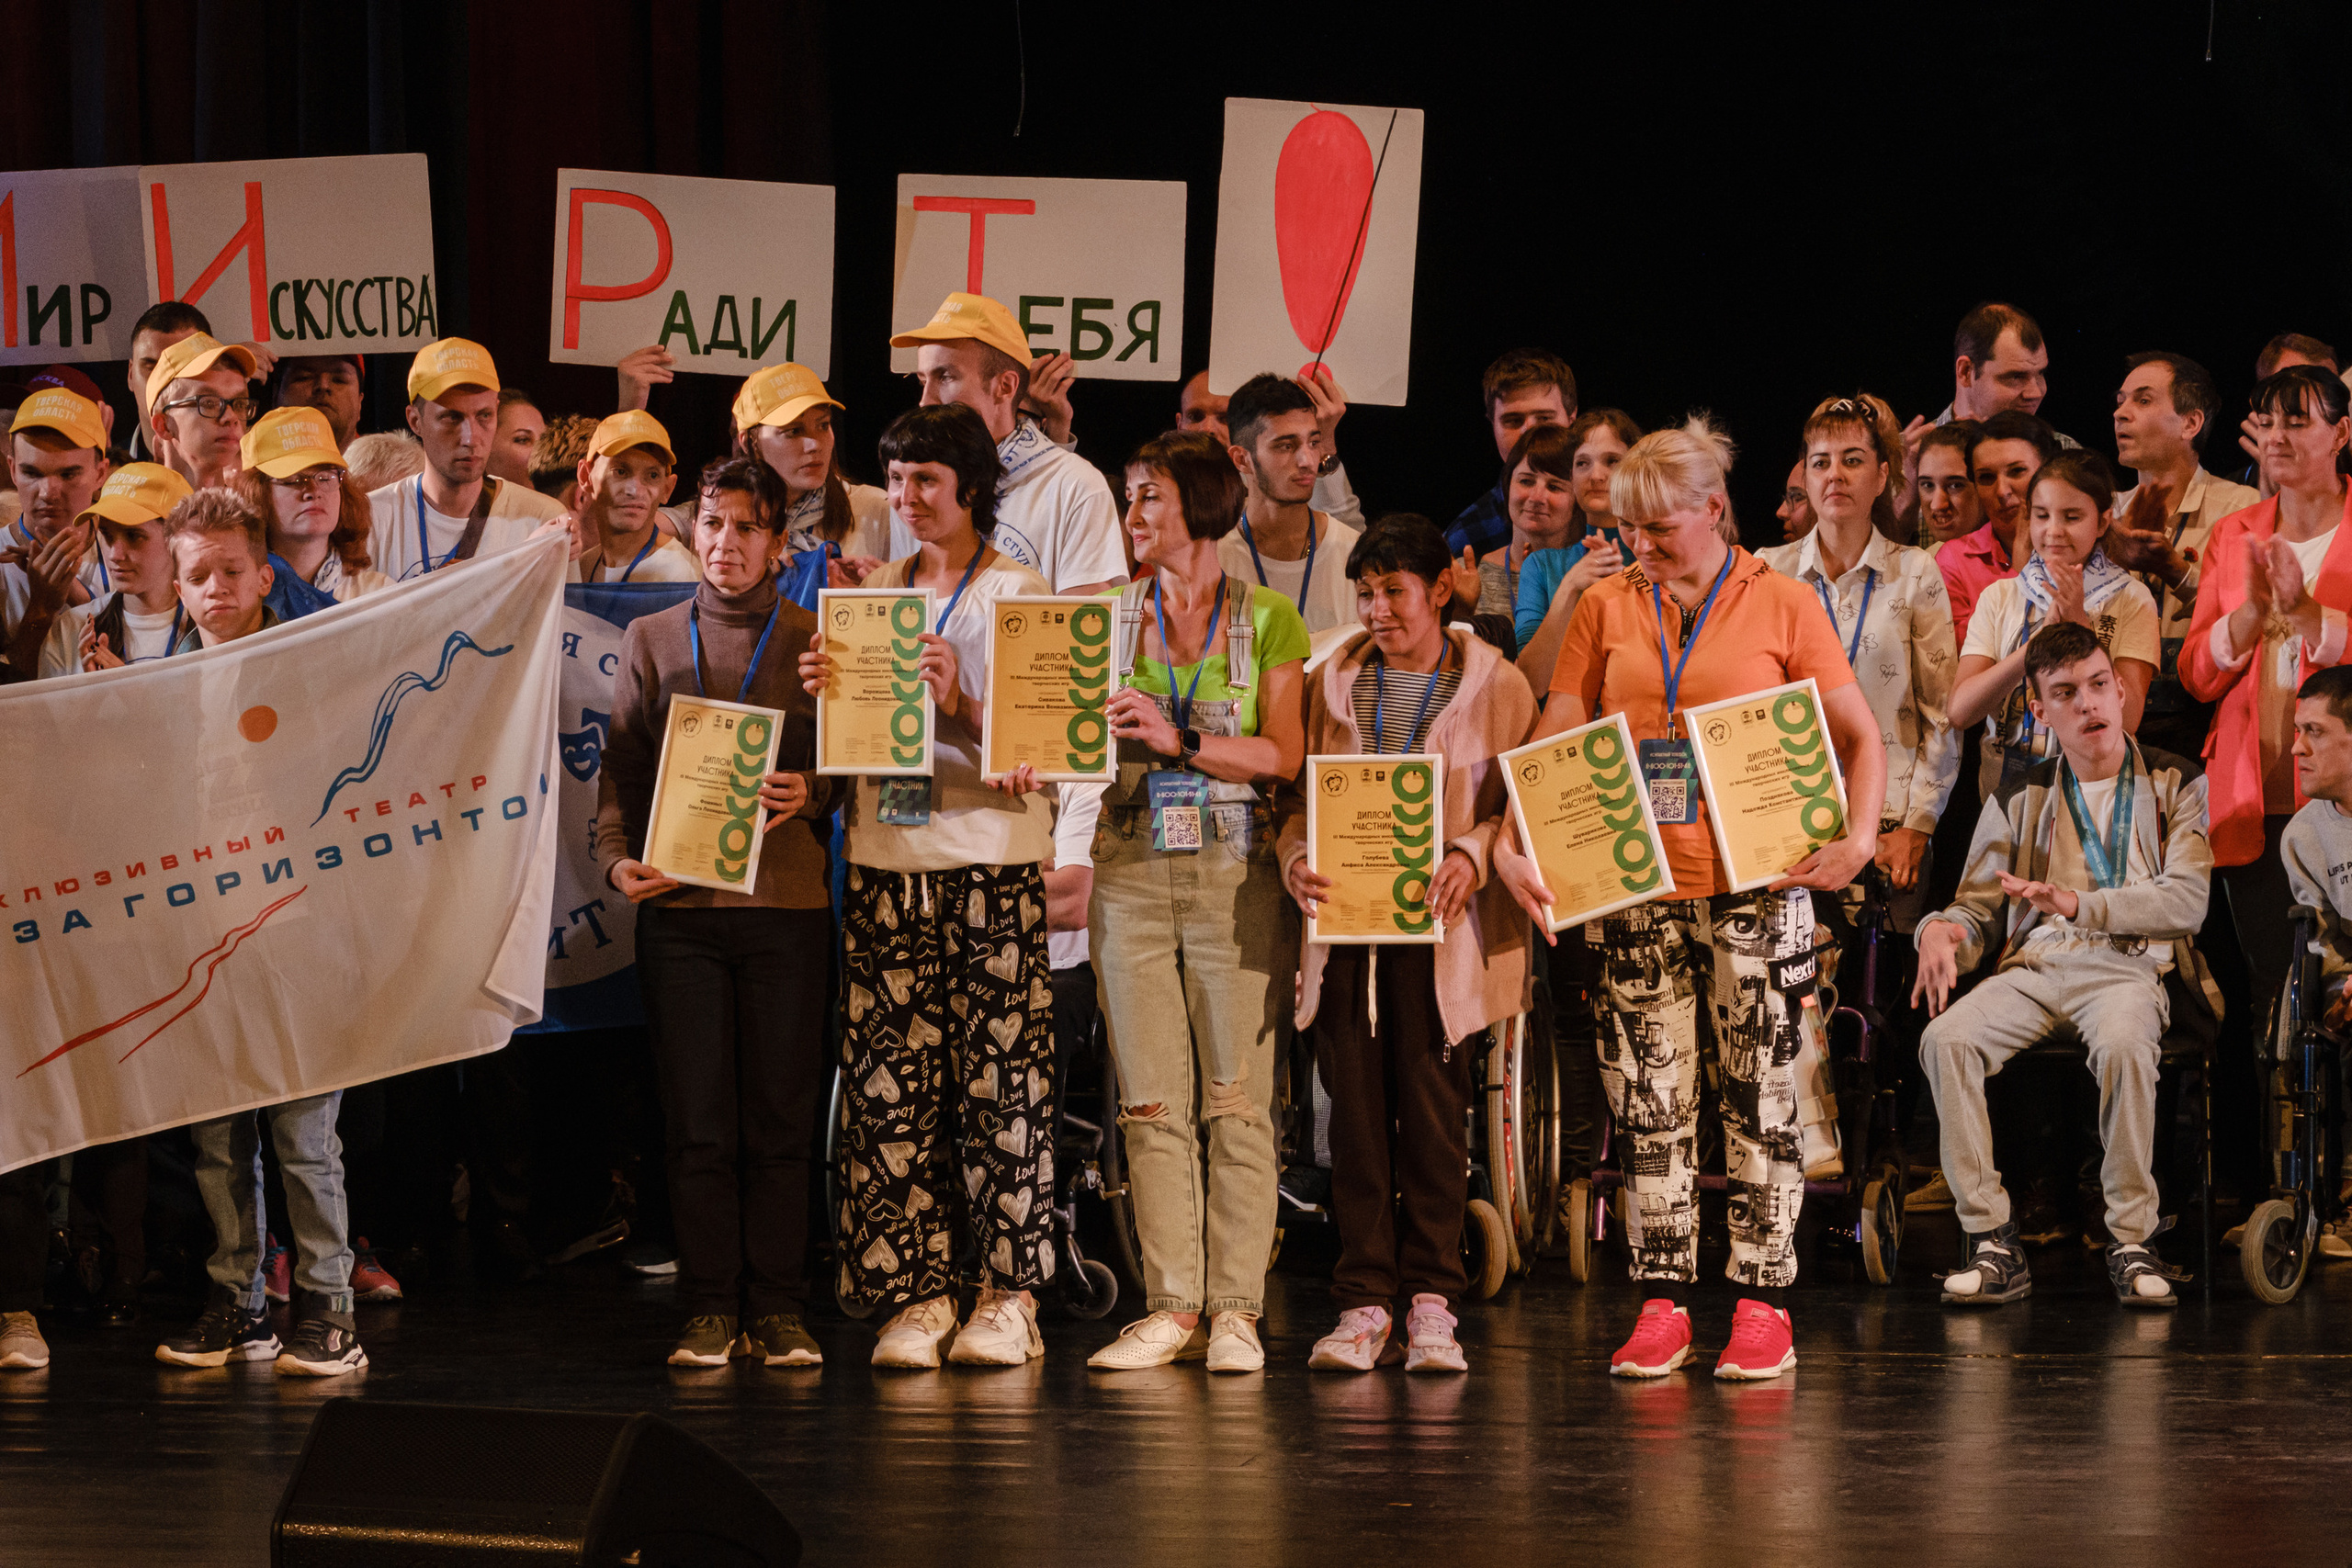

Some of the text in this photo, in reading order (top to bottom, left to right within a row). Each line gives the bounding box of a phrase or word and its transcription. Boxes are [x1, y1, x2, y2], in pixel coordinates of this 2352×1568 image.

[151, 181, 438, 343] ИСКУССТВА
[563, 187, 797, 362] РАДИ
[913, 195, 1160, 364] ТЕБЯ
[35, 395, 84, 412] ТВЕРСКАЯ
[32, 406, 77, 423] ОБЛАСТЬ
[1002, 536, 1031, 567] СТУД
[861, 646, 890, 655] ДИПЛОМ
[1035, 653, 1069, 661] ДИПЛОМ
[856, 656, 895, 665] УЧАСТНИКА
[1030, 663, 1073, 671] УЧАСТНИКА
[703, 755, 732, 767] ДИПЛОМ
[1747, 746, 1781, 762] ДИПЛОМ
[696, 764, 734, 779] УЧАСТНИКА
[1744, 755, 1790, 774] УЧАСТНИКА
[343, 774, 488, 822] ТЕАТР
[1560, 782, 1593, 800] ДИПЛОМ
[1557, 791, 1602, 813] УЧАСТНИКА
[1357, 810, 1392, 820] ДИПЛОМ
[1351, 821, 1396, 831] УЧАСТНИКА
[13, 908, 93, 944] ЗА
